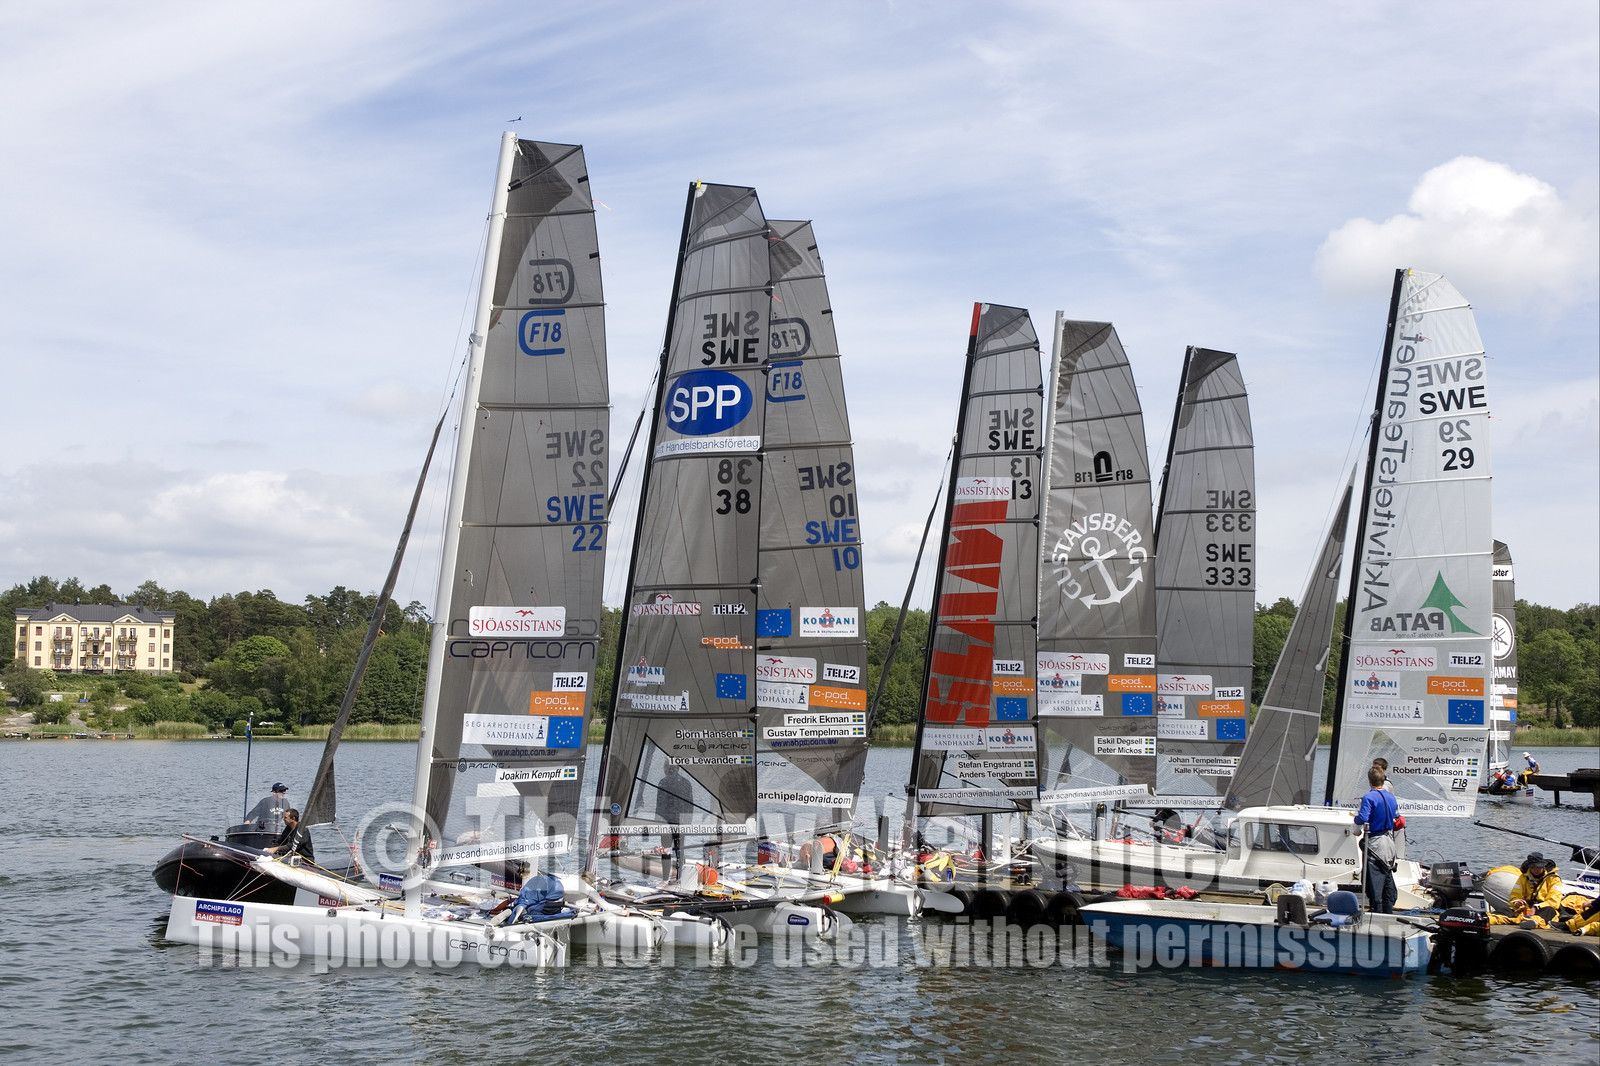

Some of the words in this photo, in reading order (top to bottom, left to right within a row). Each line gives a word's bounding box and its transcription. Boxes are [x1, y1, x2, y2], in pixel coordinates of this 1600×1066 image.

[529, 321, 562, 343] F18
[701, 338, 760, 365] SWE
[772, 372, 803, 391] F18
[670, 384, 742, 423] SPP
[1419, 386, 1487, 414] SWE
[666, 439, 759, 452] Handelsbanksföretag
[988, 429, 1035, 450] SWE
[1442, 447, 1475, 471] 29
[1012, 479, 1032, 500] 13
[546, 494, 605, 522] SWE
[716, 489, 751, 515] 38
[805, 519, 858, 544] SWE
[572, 525, 603, 551] 22
[1052, 512, 1148, 600] GUSTAVSBERG
[1206, 543, 1251, 562] SWE
[832, 547, 859, 571] 10
[1205, 567, 1251, 586] 333
[472, 617, 562, 633] SJÖASSISTANS
[803, 617, 855, 625] KOMPANI
[1038, 660, 1106, 672] SJÖASSISTANS
[1127, 657, 1152, 666] TELE2
[1356, 655, 1434, 667] SJÖASSISTANS
[1452, 656, 1481, 665] TELE2
[995, 663, 1021, 672] TELE2
[826, 668, 856, 680] TELE2
[555, 676, 584, 688] TELE2
[1354, 680, 1397, 688] KOMPANI
[1217, 689, 1241, 698] TELE2
[787, 715, 818, 724] Fredrik
[820, 715, 850, 724] Ekman
[1365, 711, 1411, 719] SANDHAMN
[465, 721, 535, 729] SEGLARHOTELLET
[486, 730, 534, 740] SANDHAMN
[675, 730, 700, 740] Björn
[702, 729, 738, 738] Hansen
[767, 729, 798, 737] Gustav
[799, 728, 850, 738] Tempelman
[989, 735, 1033, 743] KOMPANI
[692, 756, 738, 765] Lewander
[958, 761, 982, 769] Stefan
[983, 760, 1022, 770] Engstrand
[1191, 757, 1232, 765] Tempelman
[1407, 756, 1433, 764] Petter
[500, 770, 531, 781] Joakim
[532, 769, 561, 780] Kempff
[1393, 766, 1421, 774] Robert
[1423, 767, 1463, 776] Albinsson
[757, 791, 851, 806] archipelagoraid.com
[920, 789, 1034, 799] www.scandinavianislands.com
[608, 825, 747, 835] www.scandinavianislands.com
[433, 840, 563, 862] www.scandinavianislands.com
[1324, 857, 1342, 865] BXC
[198, 903, 242, 914] ARCHIPELAGO
[197, 913, 214, 921] RAID
[1444, 915, 1475, 923] MERCURY
